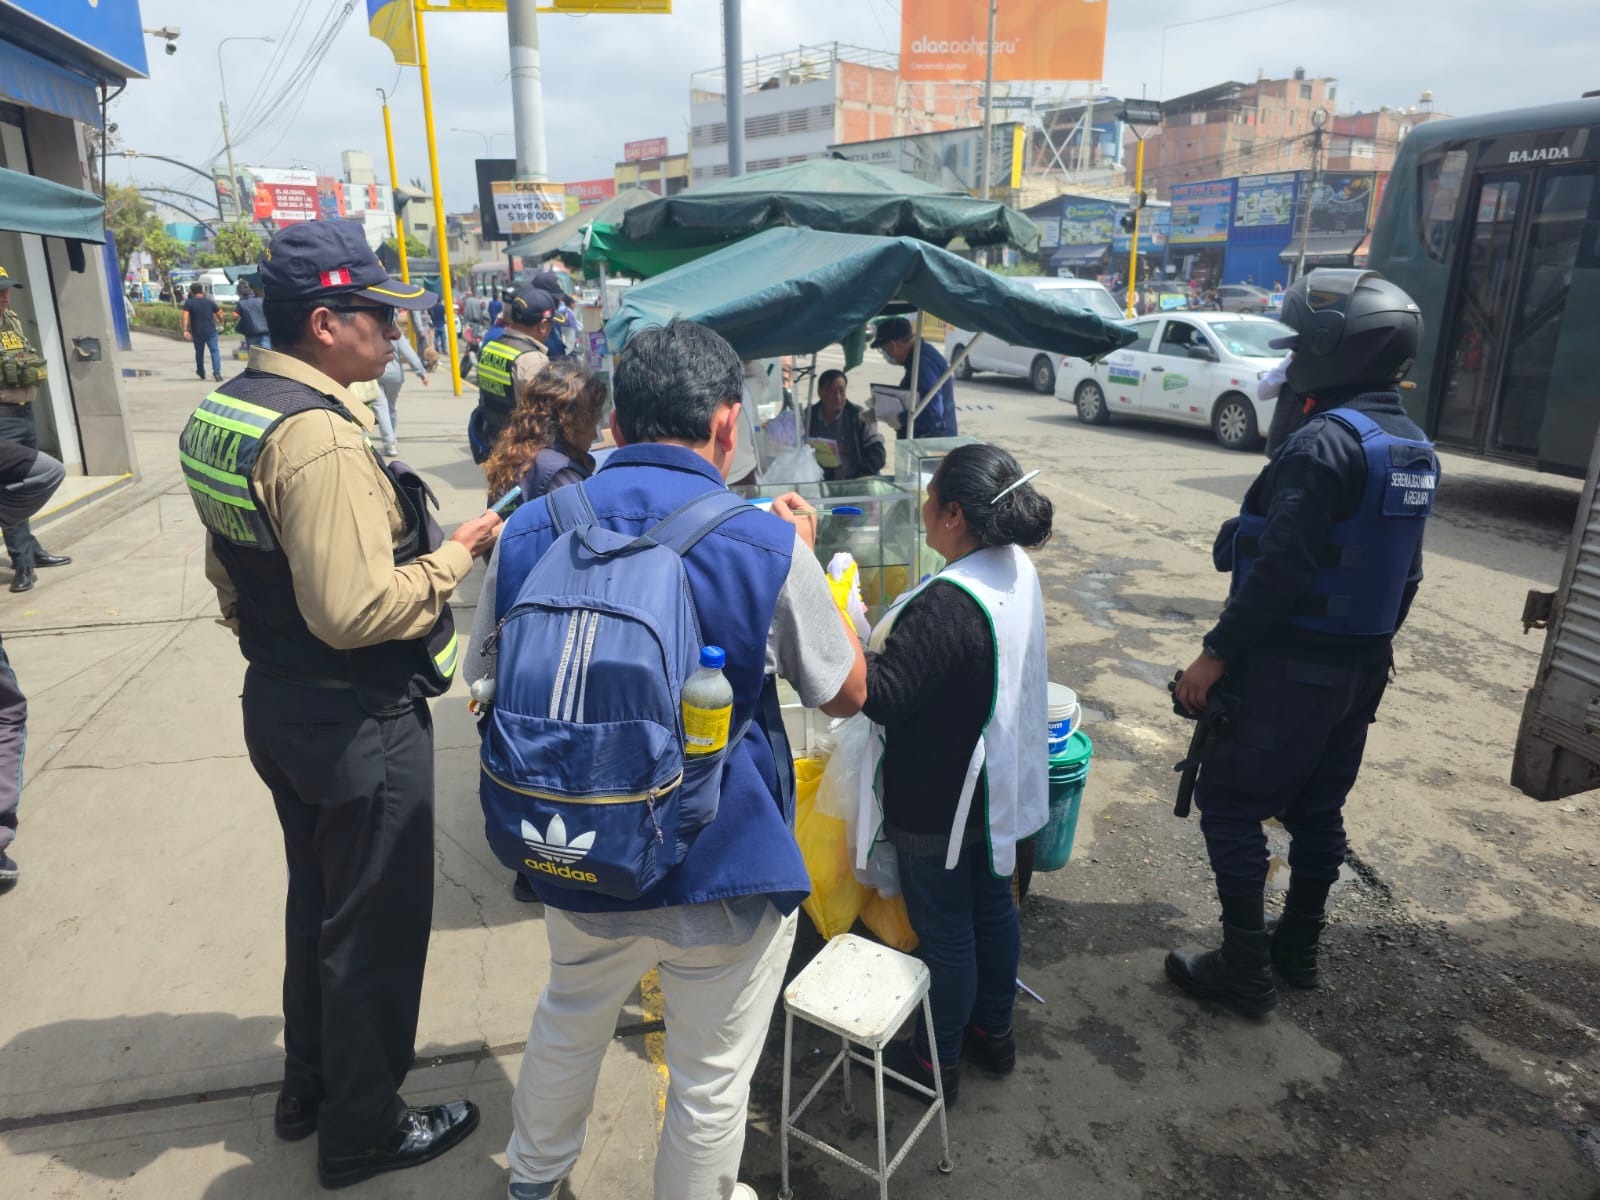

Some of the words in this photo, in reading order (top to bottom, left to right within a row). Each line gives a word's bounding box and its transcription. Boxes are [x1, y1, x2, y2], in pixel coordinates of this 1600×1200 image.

[1507, 146, 1569, 163] BAJADA
[497, 203, 510, 211] EN
[524, 858, 599, 883] adidas
